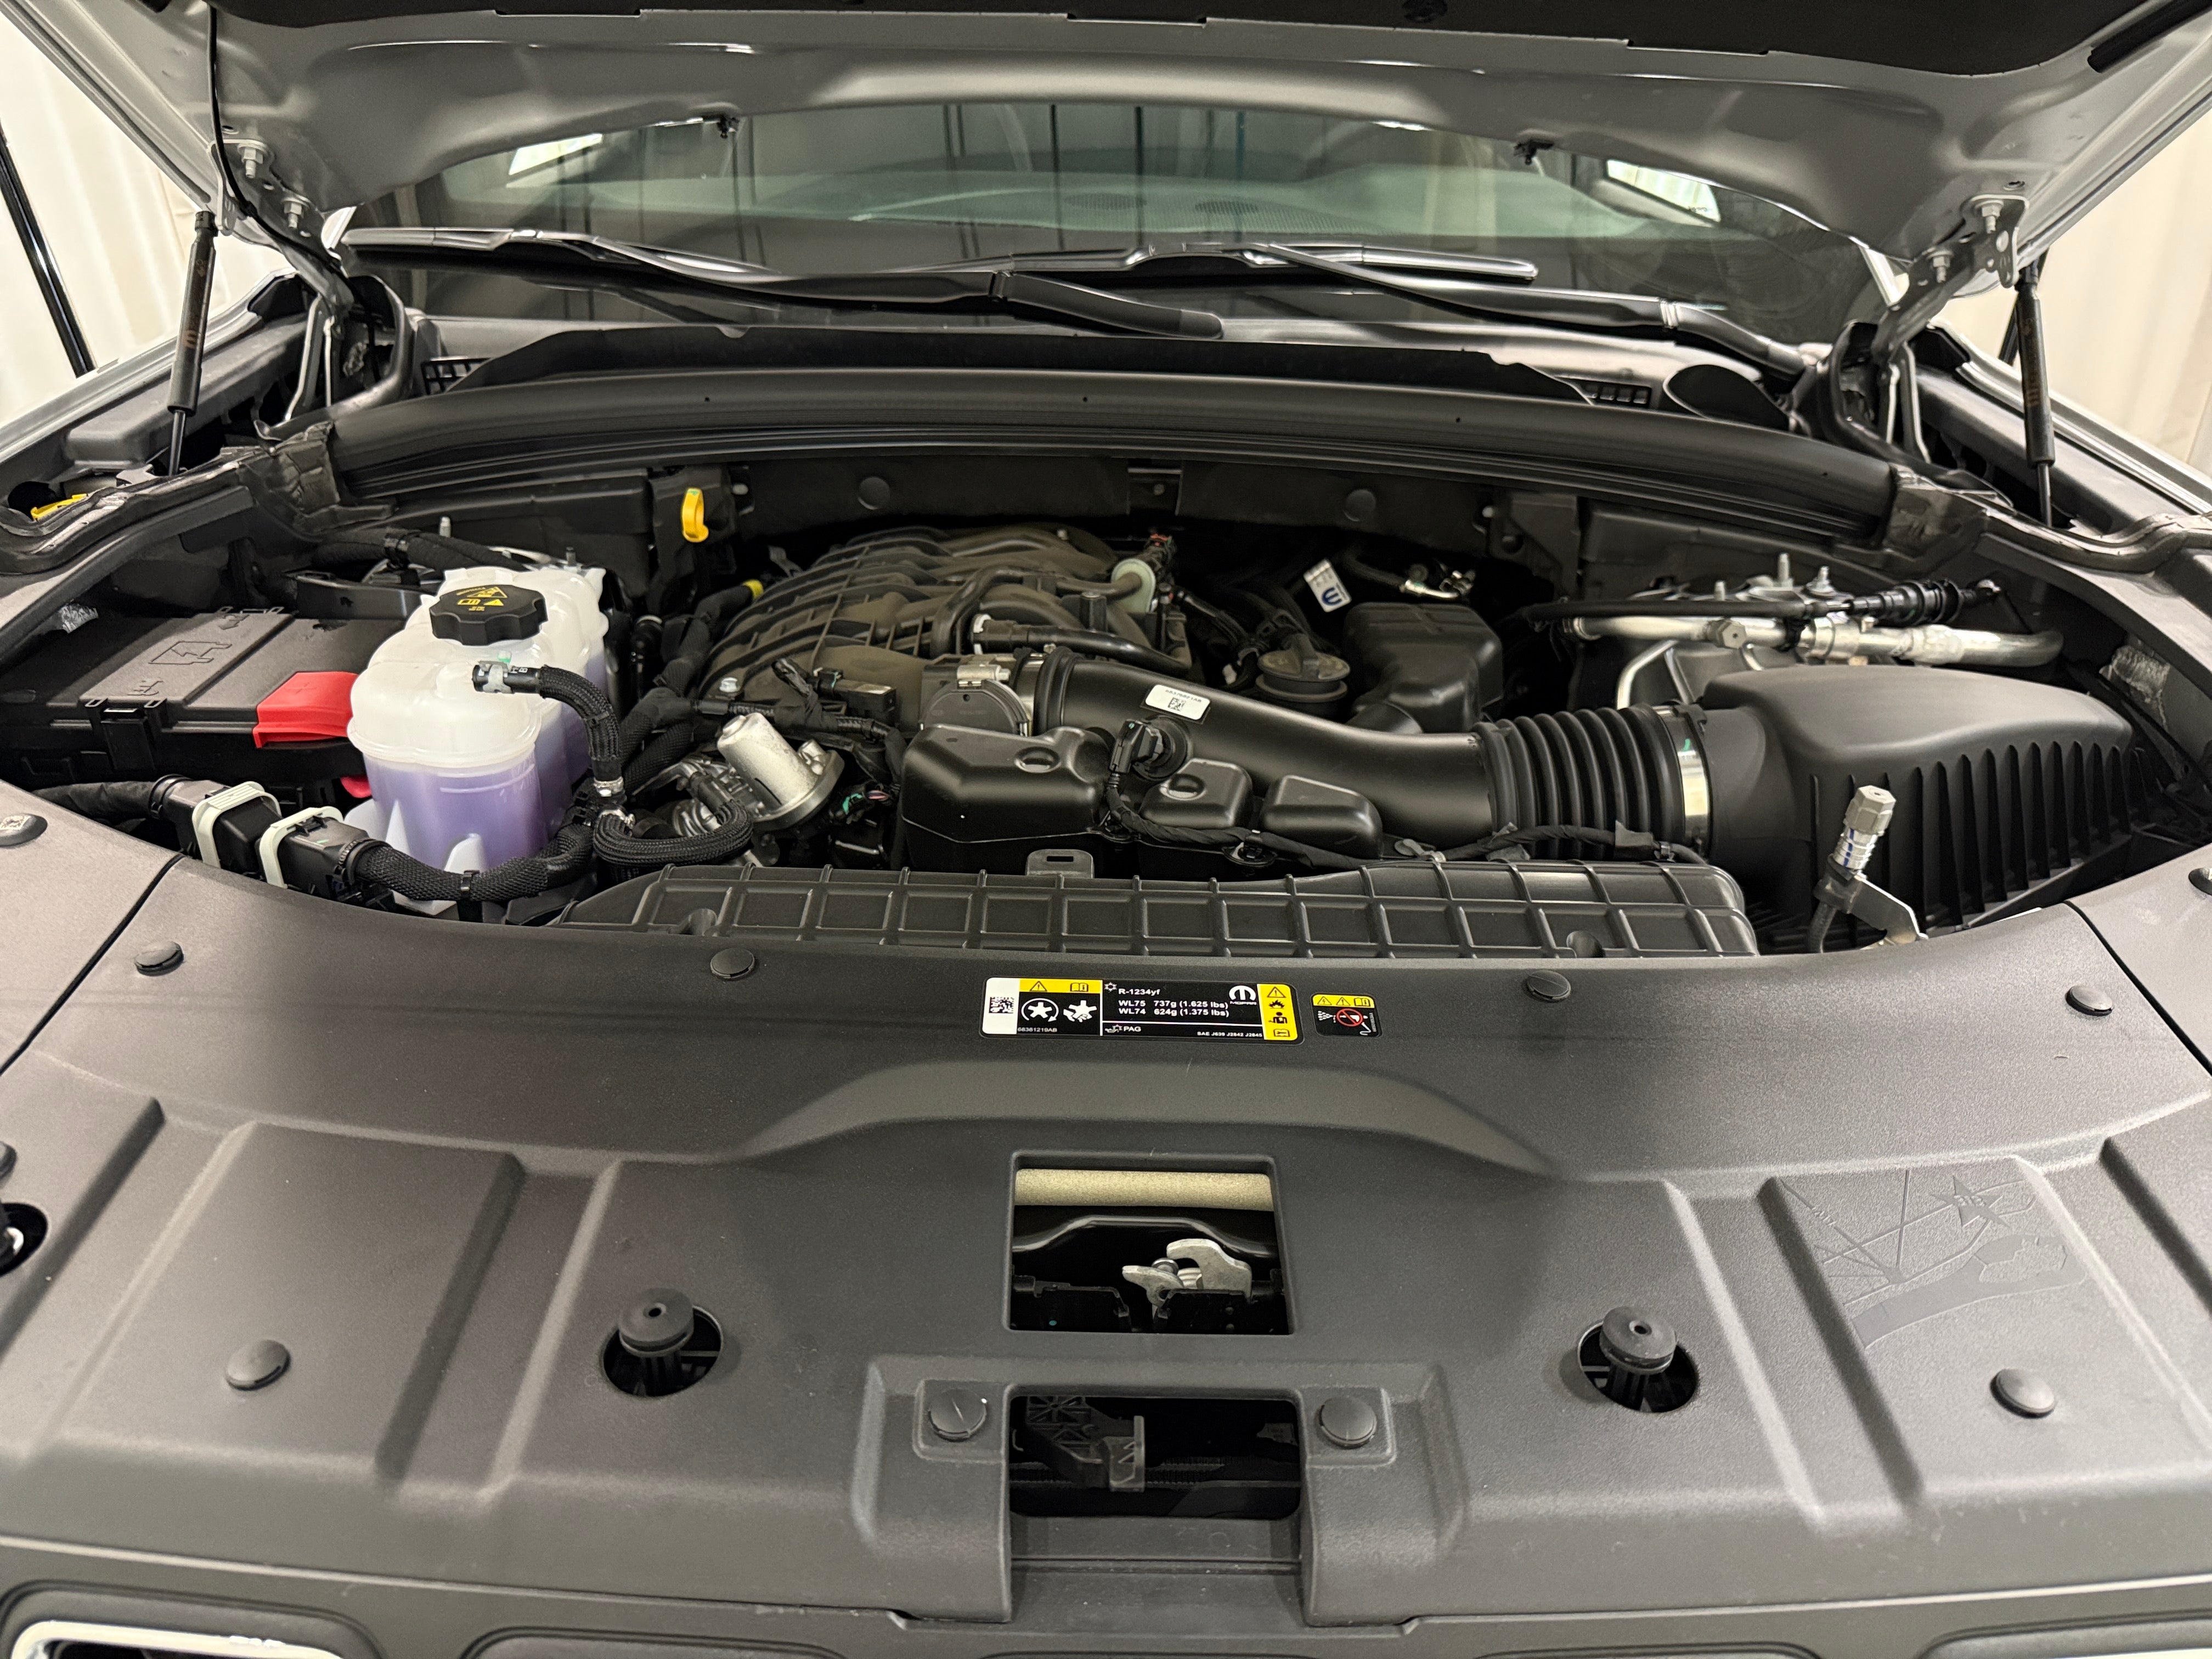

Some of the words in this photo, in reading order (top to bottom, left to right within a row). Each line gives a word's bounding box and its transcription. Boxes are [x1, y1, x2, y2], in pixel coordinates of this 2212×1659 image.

[1118, 988, 1160, 996] R-1234yf
[1153, 1000, 1177, 1008] 737g
[1179, 1000, 1209, 1008] (1.625
[1210, 1001, 1229, 1010] lbs)
[1154, 1008, 1178, 1017] 624g
[1180, 1008, 1209, 1017] (1.375
[1211, 1009, 1229, 1018] lbs)
